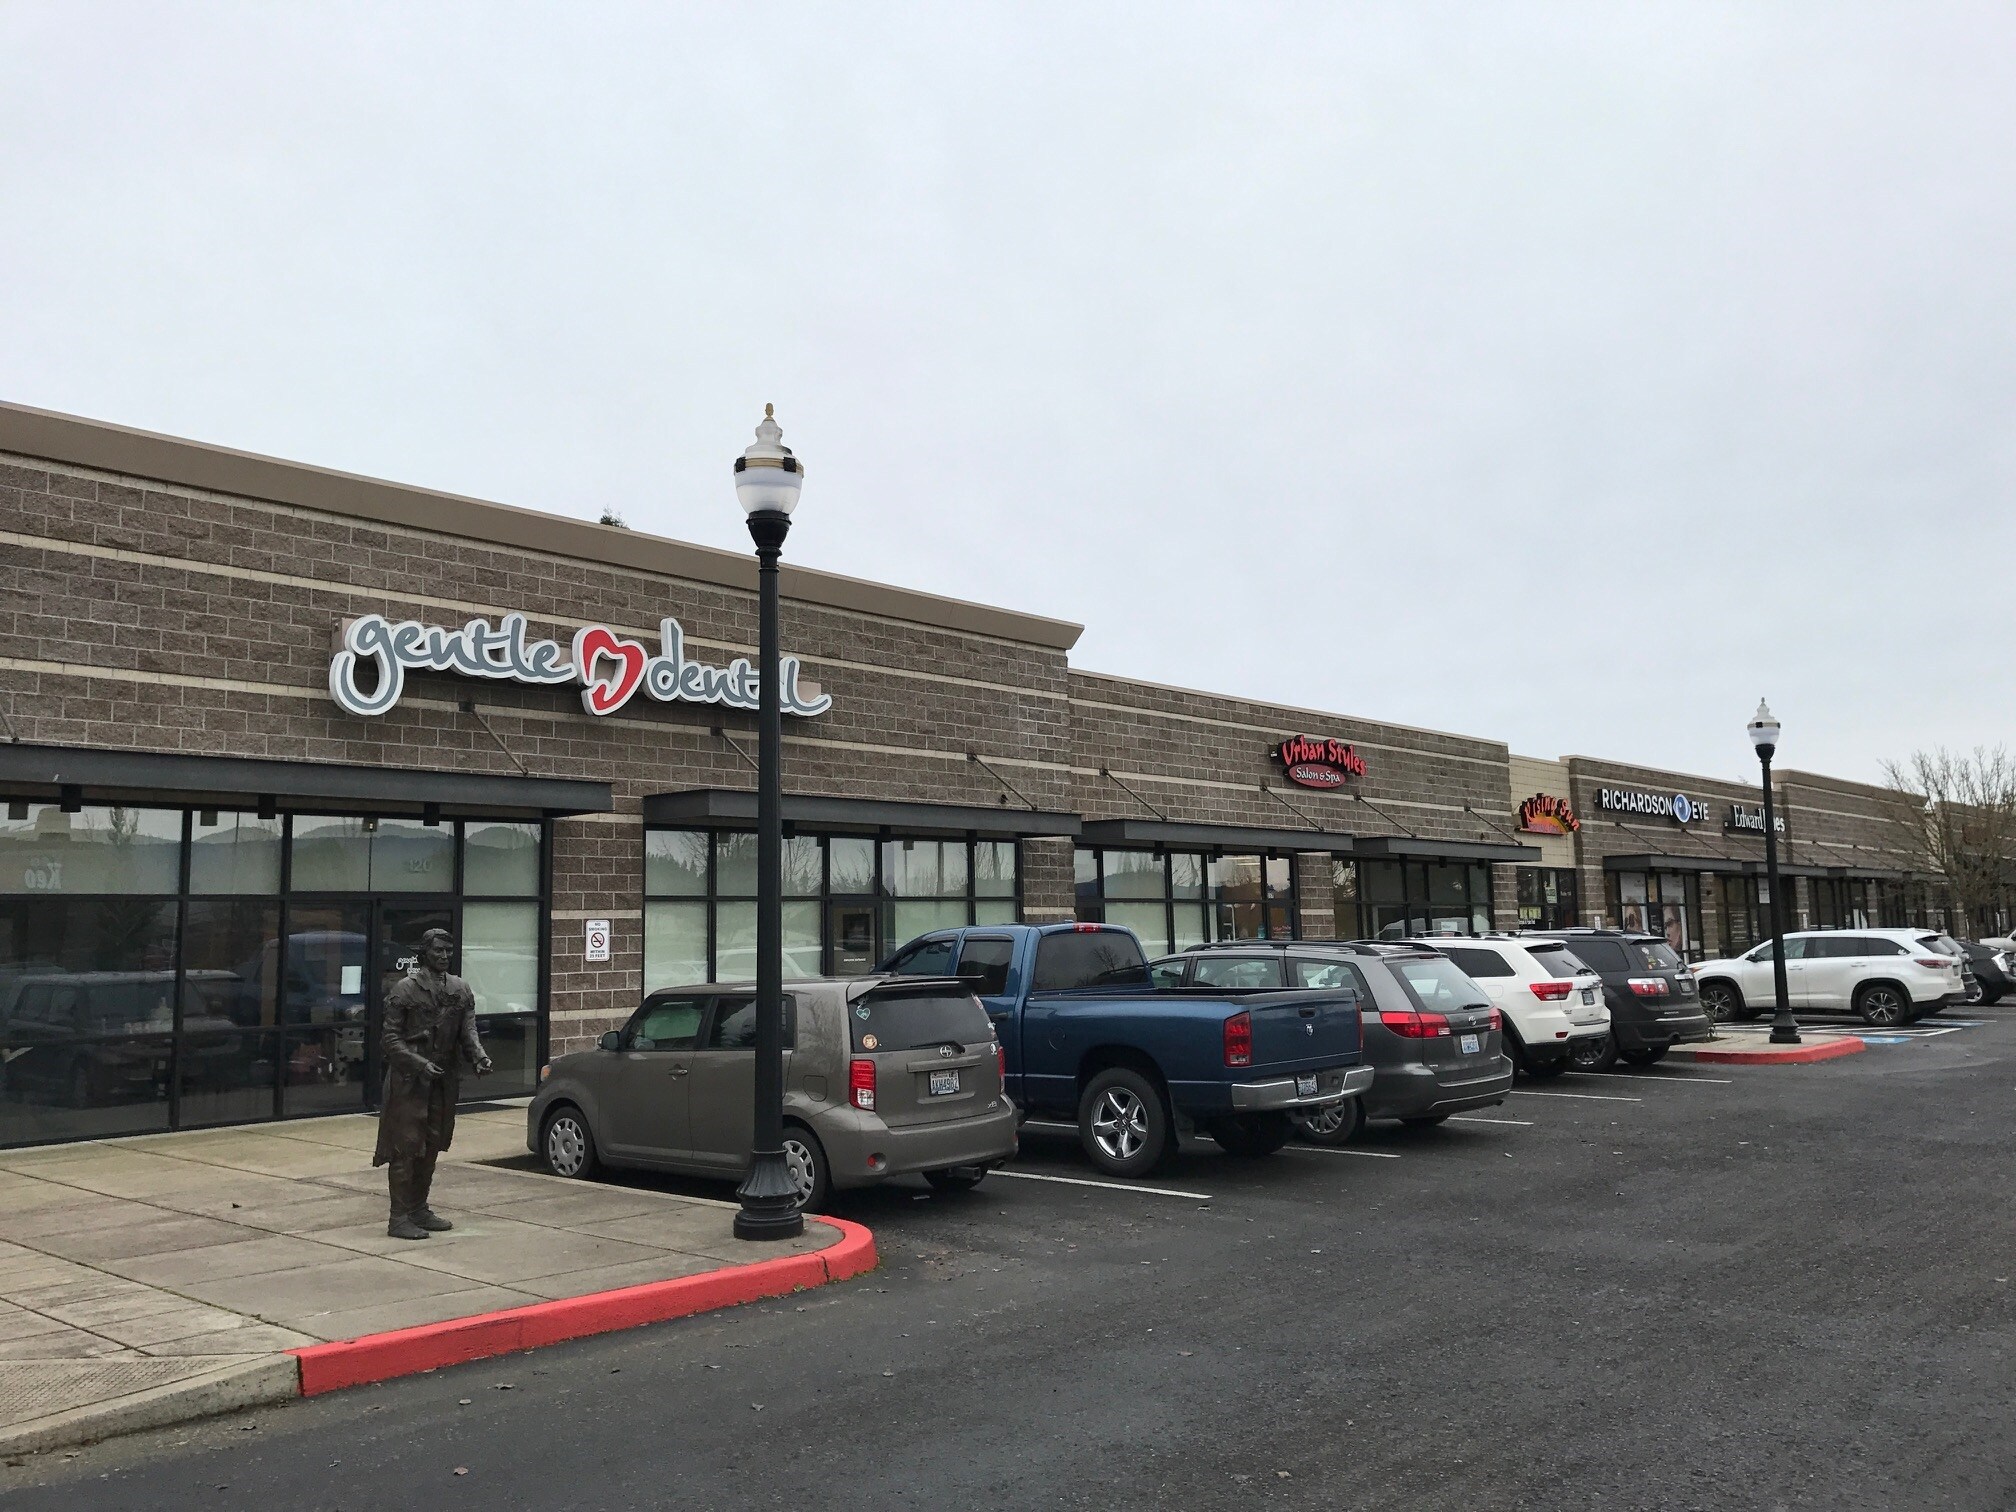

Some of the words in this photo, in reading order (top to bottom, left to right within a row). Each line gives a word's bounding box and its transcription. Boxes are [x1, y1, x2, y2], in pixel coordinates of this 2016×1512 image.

[334, 614, 576, 713] gentle
[645, 618, 832, 715] dentl
[1282, 734, 1325, 766] Urban
[1328, 738, 1367, 776] Styles
[1296, 767, 1319, 780] Salon
[1325, 770, 1341, 784] Spa
[1602, 788, 1673, 816] RICHARDSON
[1691, 801, 1710, 820] EYE
[1733, 804, 1764, 830] Edward
